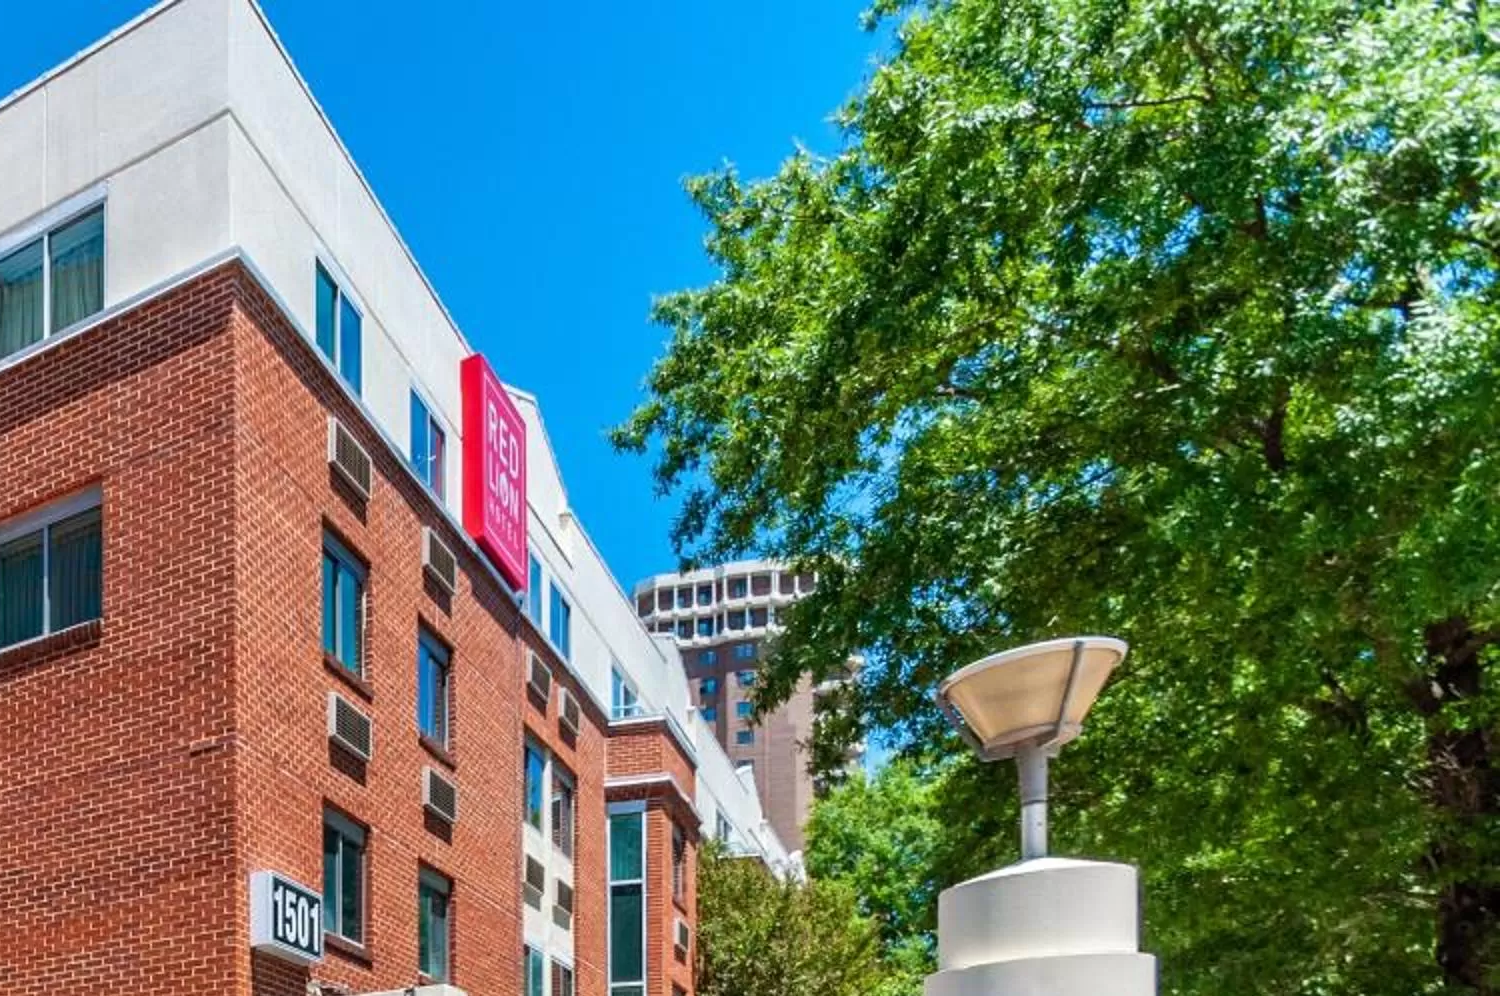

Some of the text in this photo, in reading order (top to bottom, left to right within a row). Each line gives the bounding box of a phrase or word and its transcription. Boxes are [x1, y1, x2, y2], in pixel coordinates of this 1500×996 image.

[488, 400, 519, 480] RED
[488, 450, 519, 524] LION
[274, 885, 320, 953] 1501
